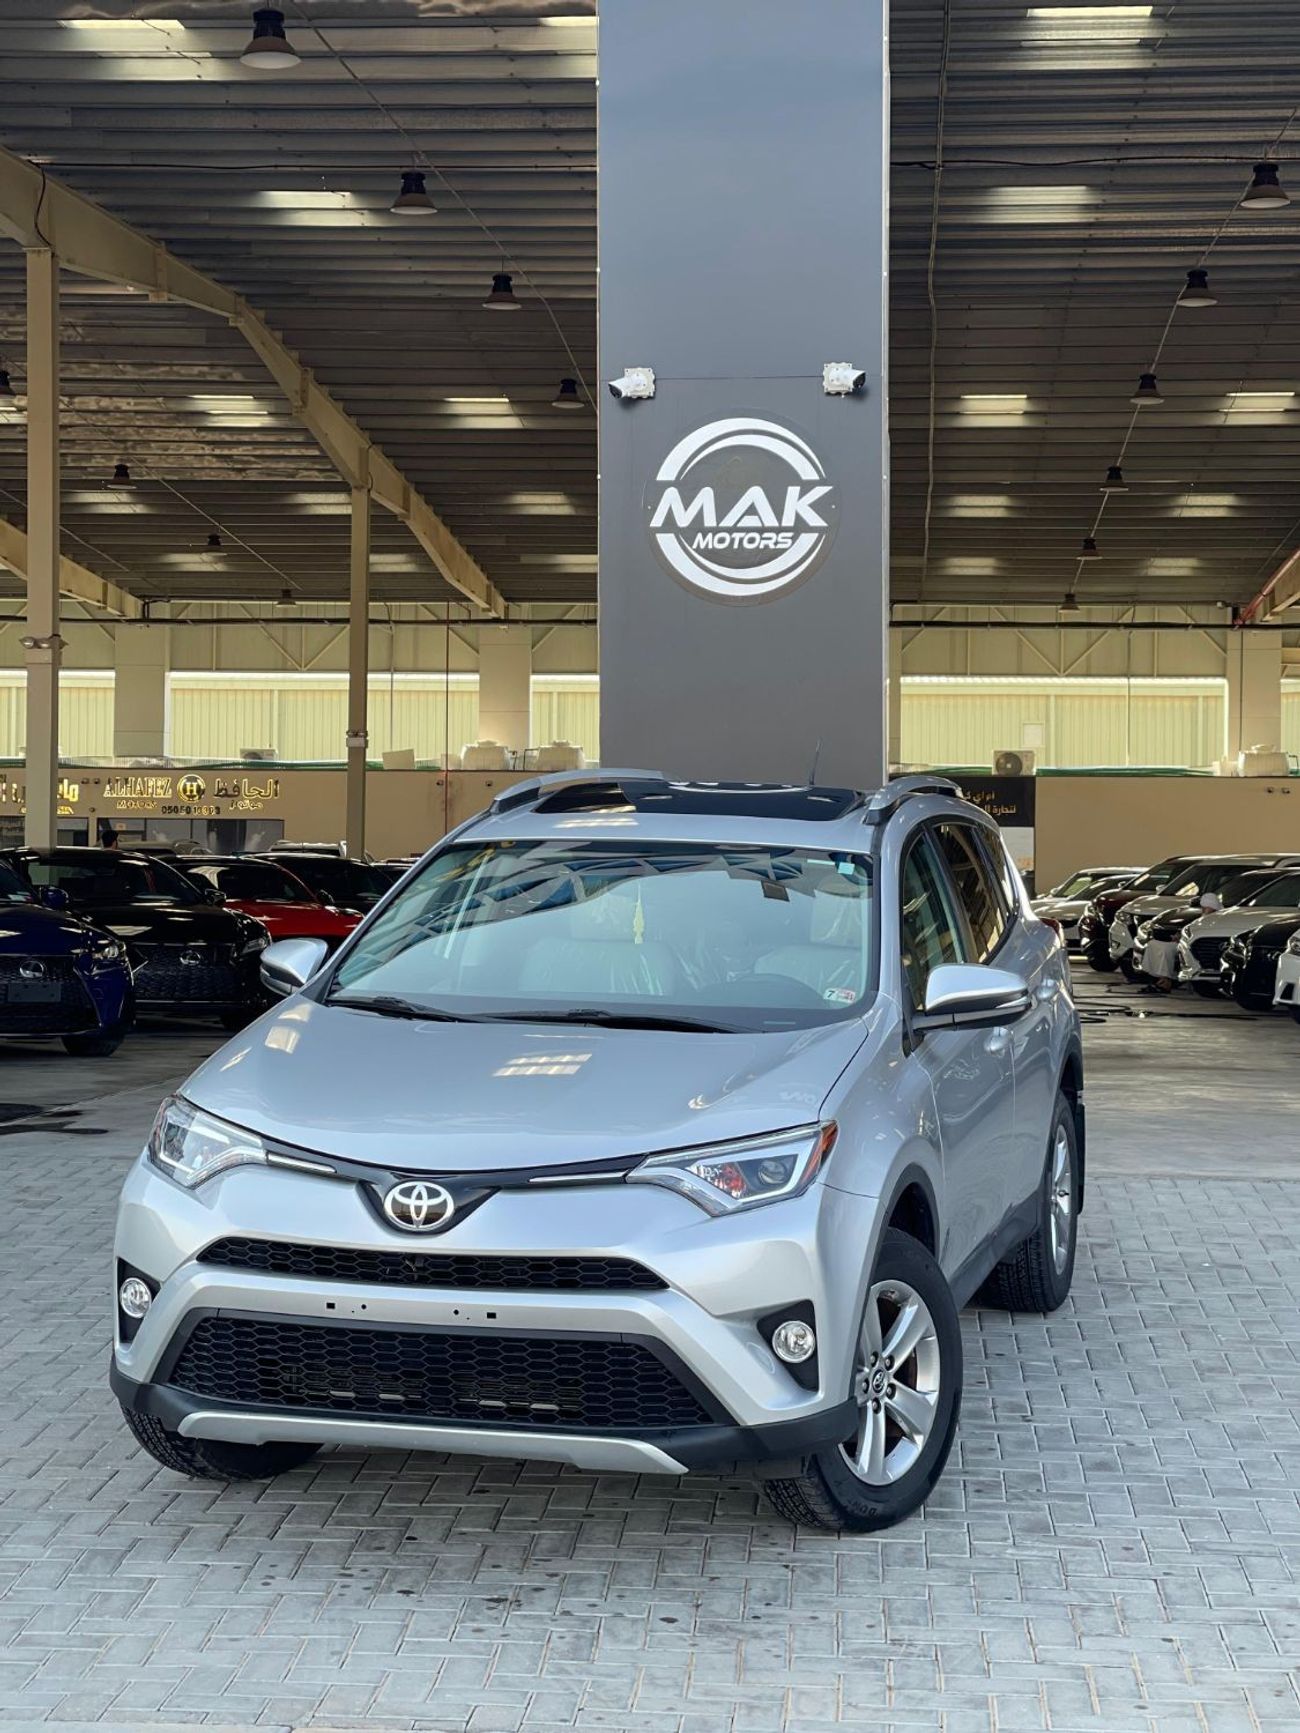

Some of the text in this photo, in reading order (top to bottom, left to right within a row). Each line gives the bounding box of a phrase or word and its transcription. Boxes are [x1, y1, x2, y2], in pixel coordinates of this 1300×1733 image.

[650, 486, 833, 527] MAK
[692, 532, 794, 549] MOTORS
[103, 777, 173, 798] ALHAFEZ
